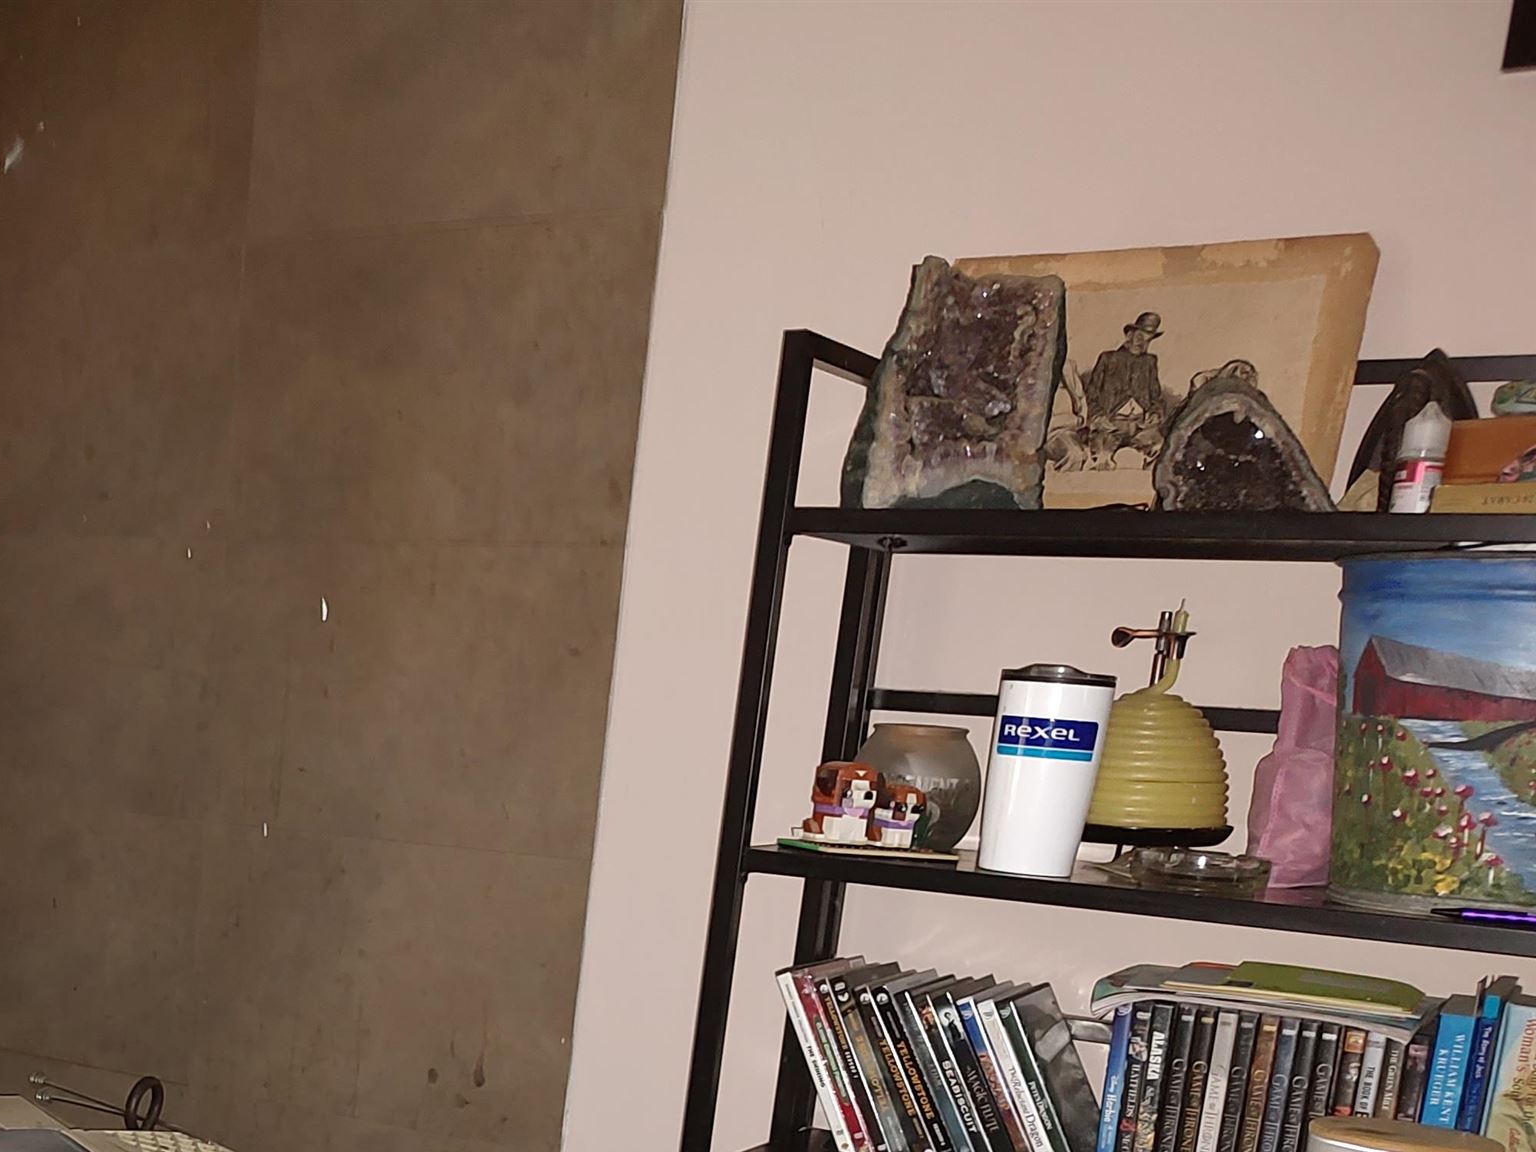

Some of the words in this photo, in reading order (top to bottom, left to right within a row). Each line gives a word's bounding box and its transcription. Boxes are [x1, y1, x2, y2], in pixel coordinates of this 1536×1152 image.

[1143, 1030, 1167, 1081] ALASKA
[1445, 1033, 1466, 1087] WILLIAM
[1516, 1017, 1536, 1073] Woman's
[877, 1038, 917, 1117] YELLOWSTONE
[895, 1039, 936, 1120] YELLOWSTONE
[1165, 1057, 1187, 1095] GAME
[1185, 1059, 1209, 1100] GAME
[1248, 1069, 1269, 1107] GAME
[1267, 1072, 1288, 1110] GAME
[1311, 1062, 1332, 1103] GAME
[1360, 1081, 1371, 1100] BOOK
[1365, 1066, 1375, 1079] THE
[1385, 1064, 1397, 1090] GREEN
[1429, 1048, 1449, 1105] KRUEGER
[938, 1059, 980, 1135] SEABISCUIT
[1102, 1093, 1117, 1123] Herbie
[1287, 1075, 1308, 1114] GAME
[1438, 1090, 1454, 1123] KENT
[1022, 1112, 1046, 1148] Dragon
